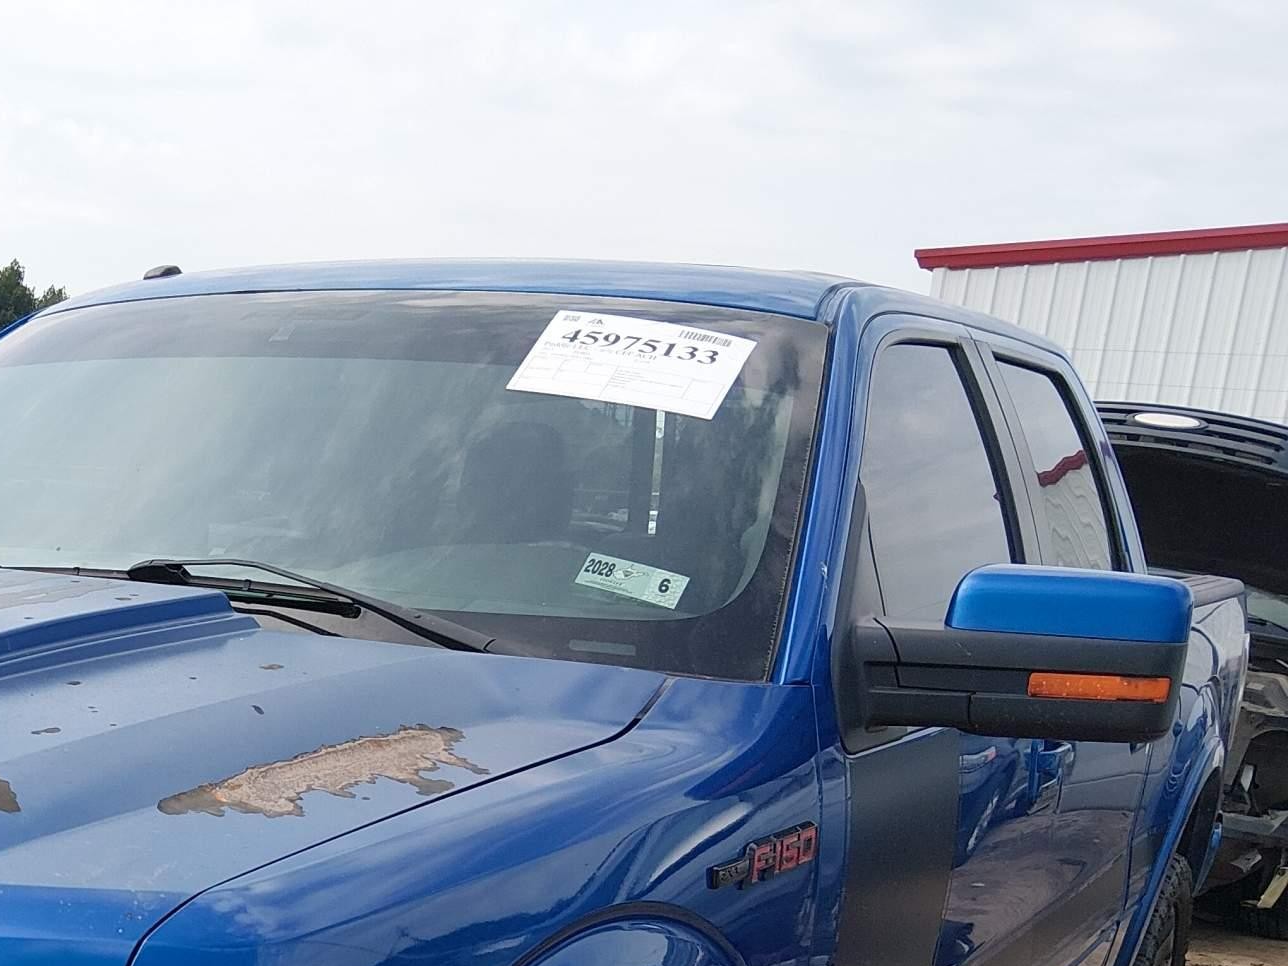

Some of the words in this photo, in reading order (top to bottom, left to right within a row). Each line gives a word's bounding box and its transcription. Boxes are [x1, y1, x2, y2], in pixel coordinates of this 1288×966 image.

[562, 329, 719, 365] 45975133
[584, 558, 616, 578] 2028
[658, 578, 671, 593] 6
